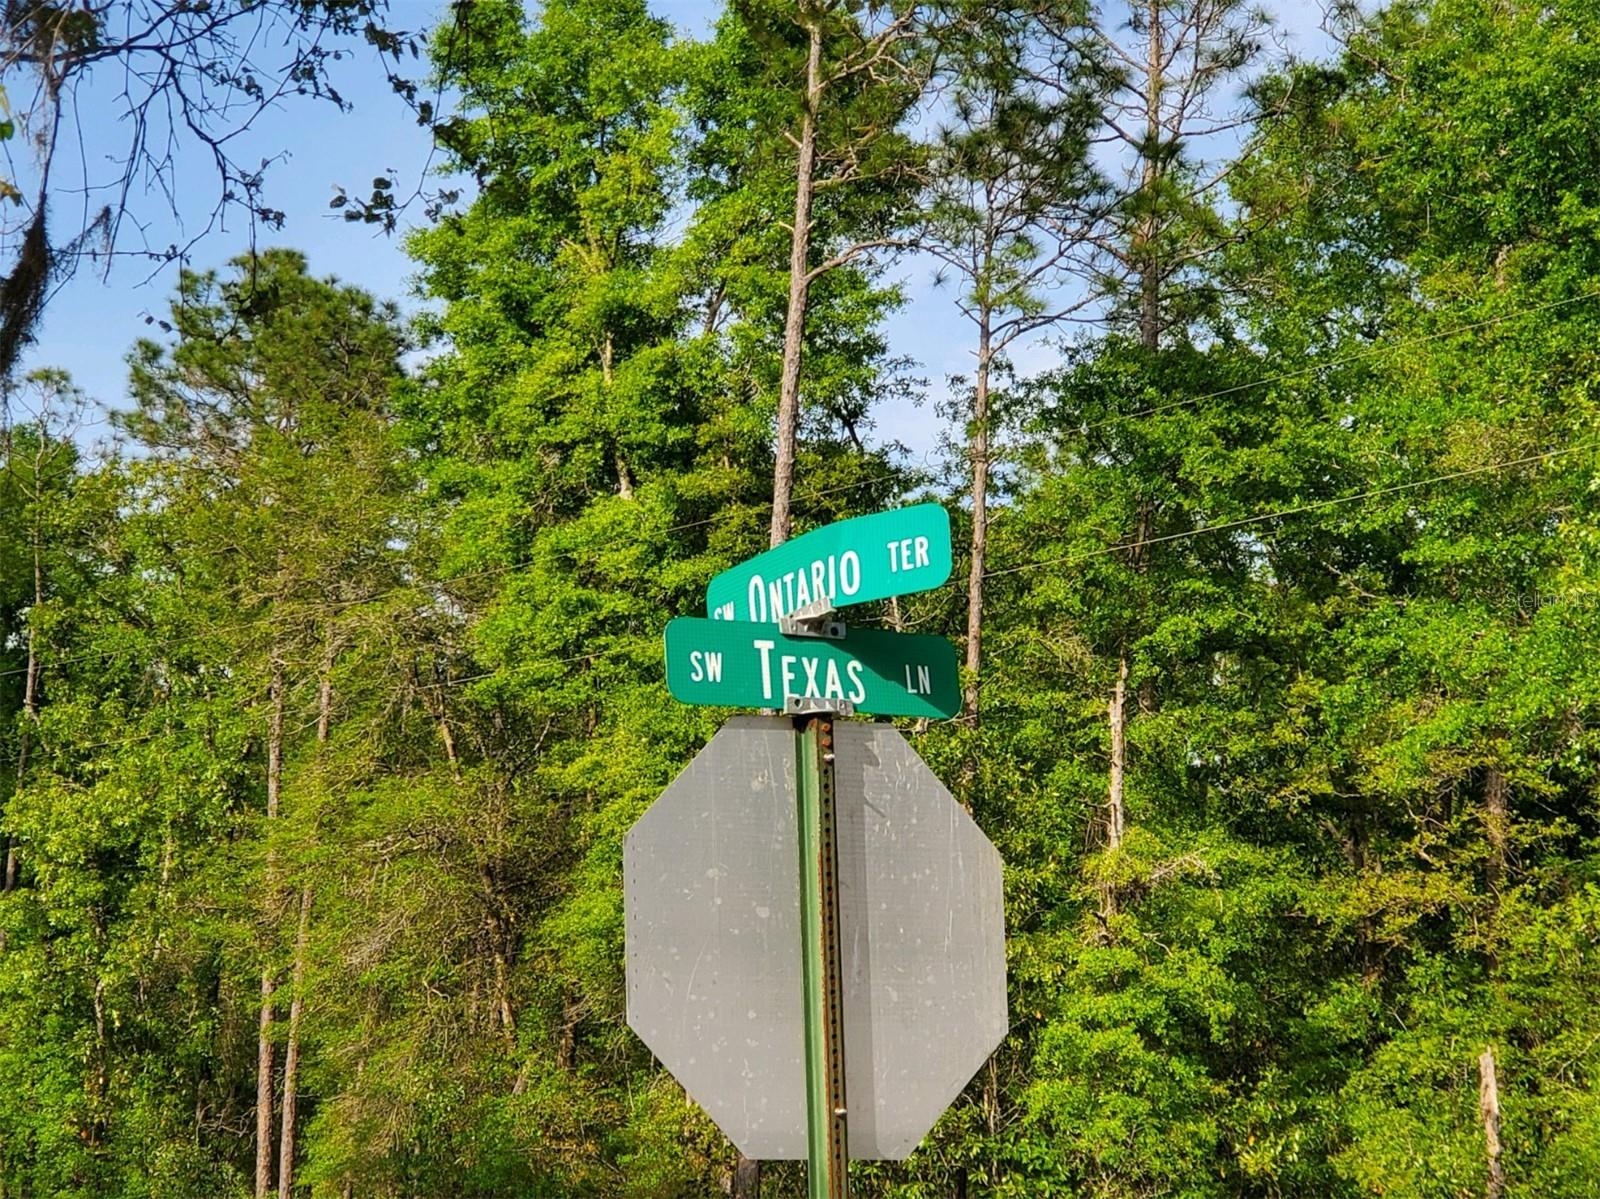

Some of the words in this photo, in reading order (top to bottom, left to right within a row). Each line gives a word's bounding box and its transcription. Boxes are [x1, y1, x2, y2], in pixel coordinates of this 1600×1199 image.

[748, 550, 861, 623] ONTARIO
[886, 536, 930, 573] TER
[690, 651, 723, 683] SW
[753, 639, 866, 705] TEXAS
[904, 664, 931, 695] LN
